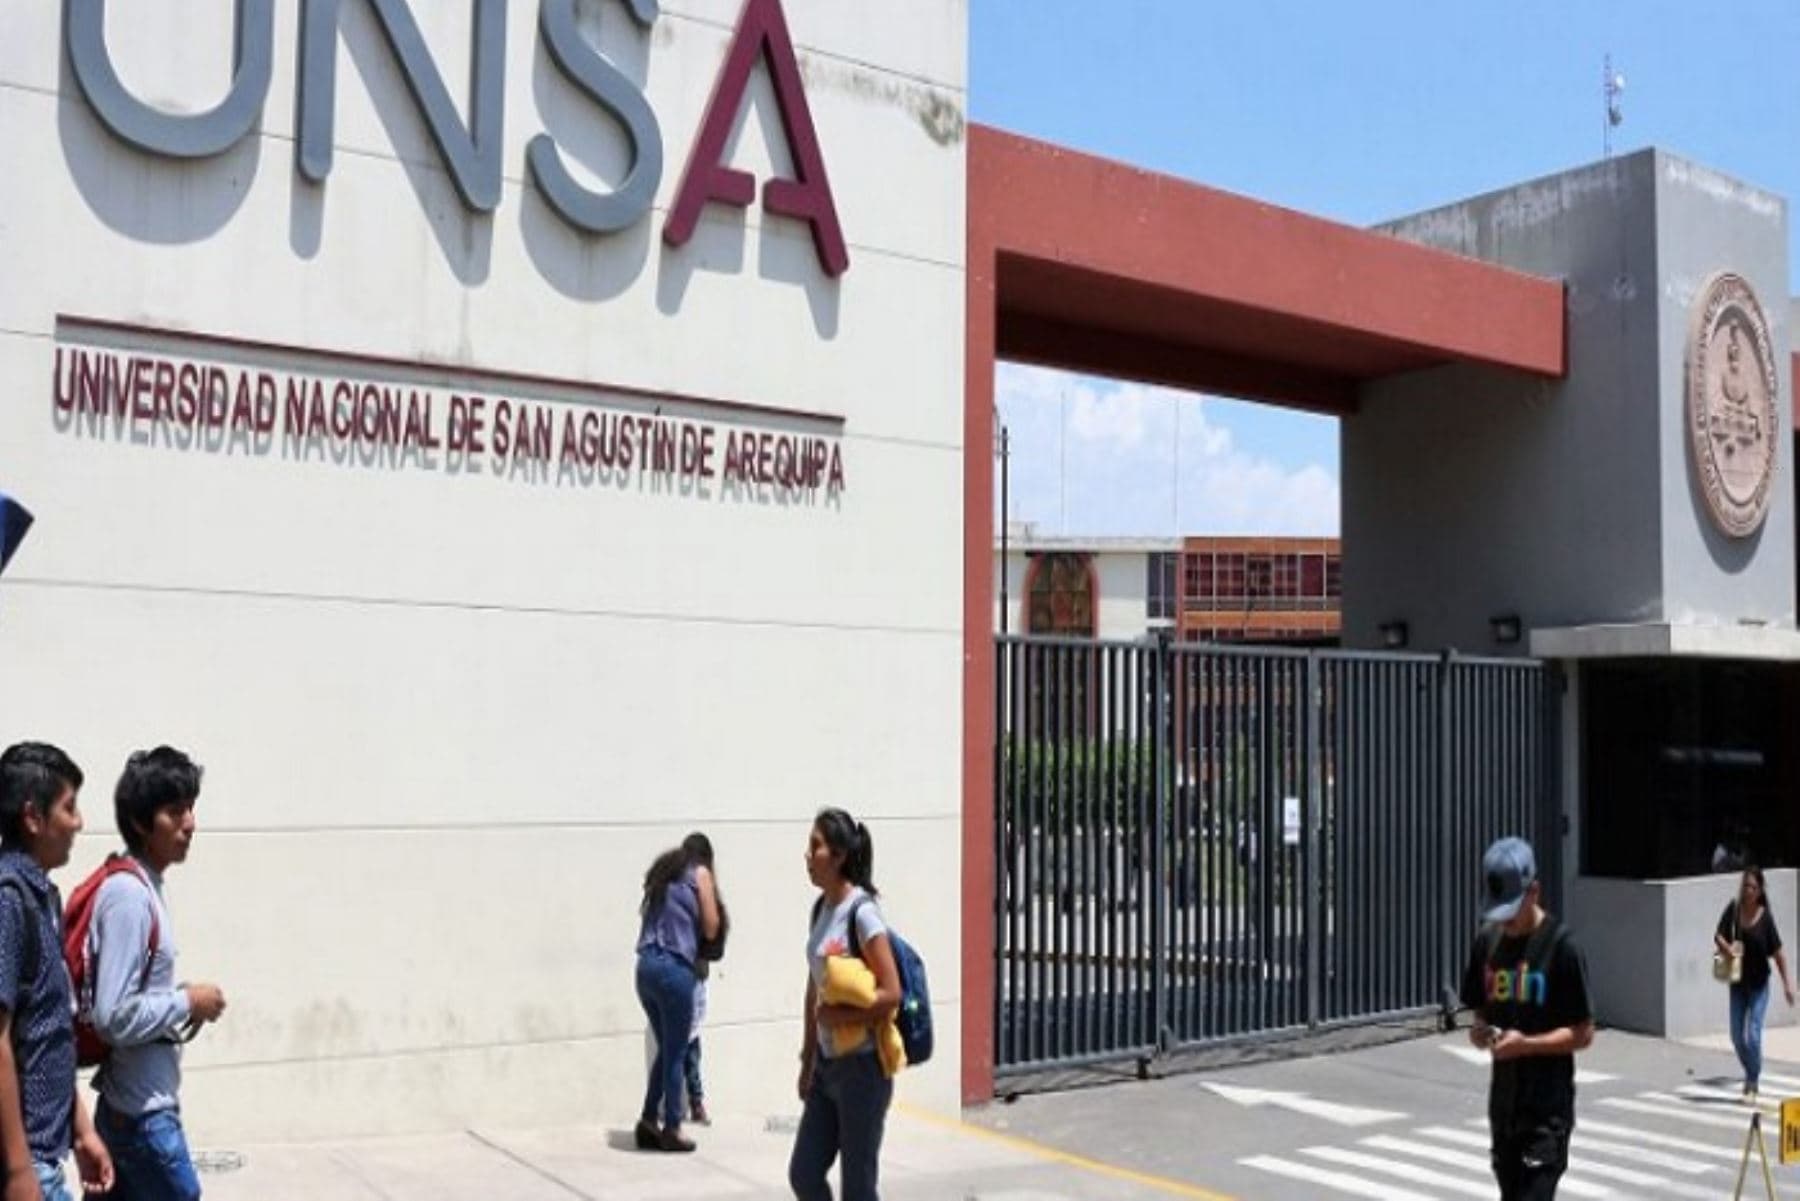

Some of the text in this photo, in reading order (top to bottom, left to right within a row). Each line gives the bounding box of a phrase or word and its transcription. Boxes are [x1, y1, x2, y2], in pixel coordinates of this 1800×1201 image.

[65, 0, 849, 277] UNSA
[54, 347, 845, 490] UNIVERSIDAD NACIONAL DE SAN AGUSTÍN DE AREQUIPA
